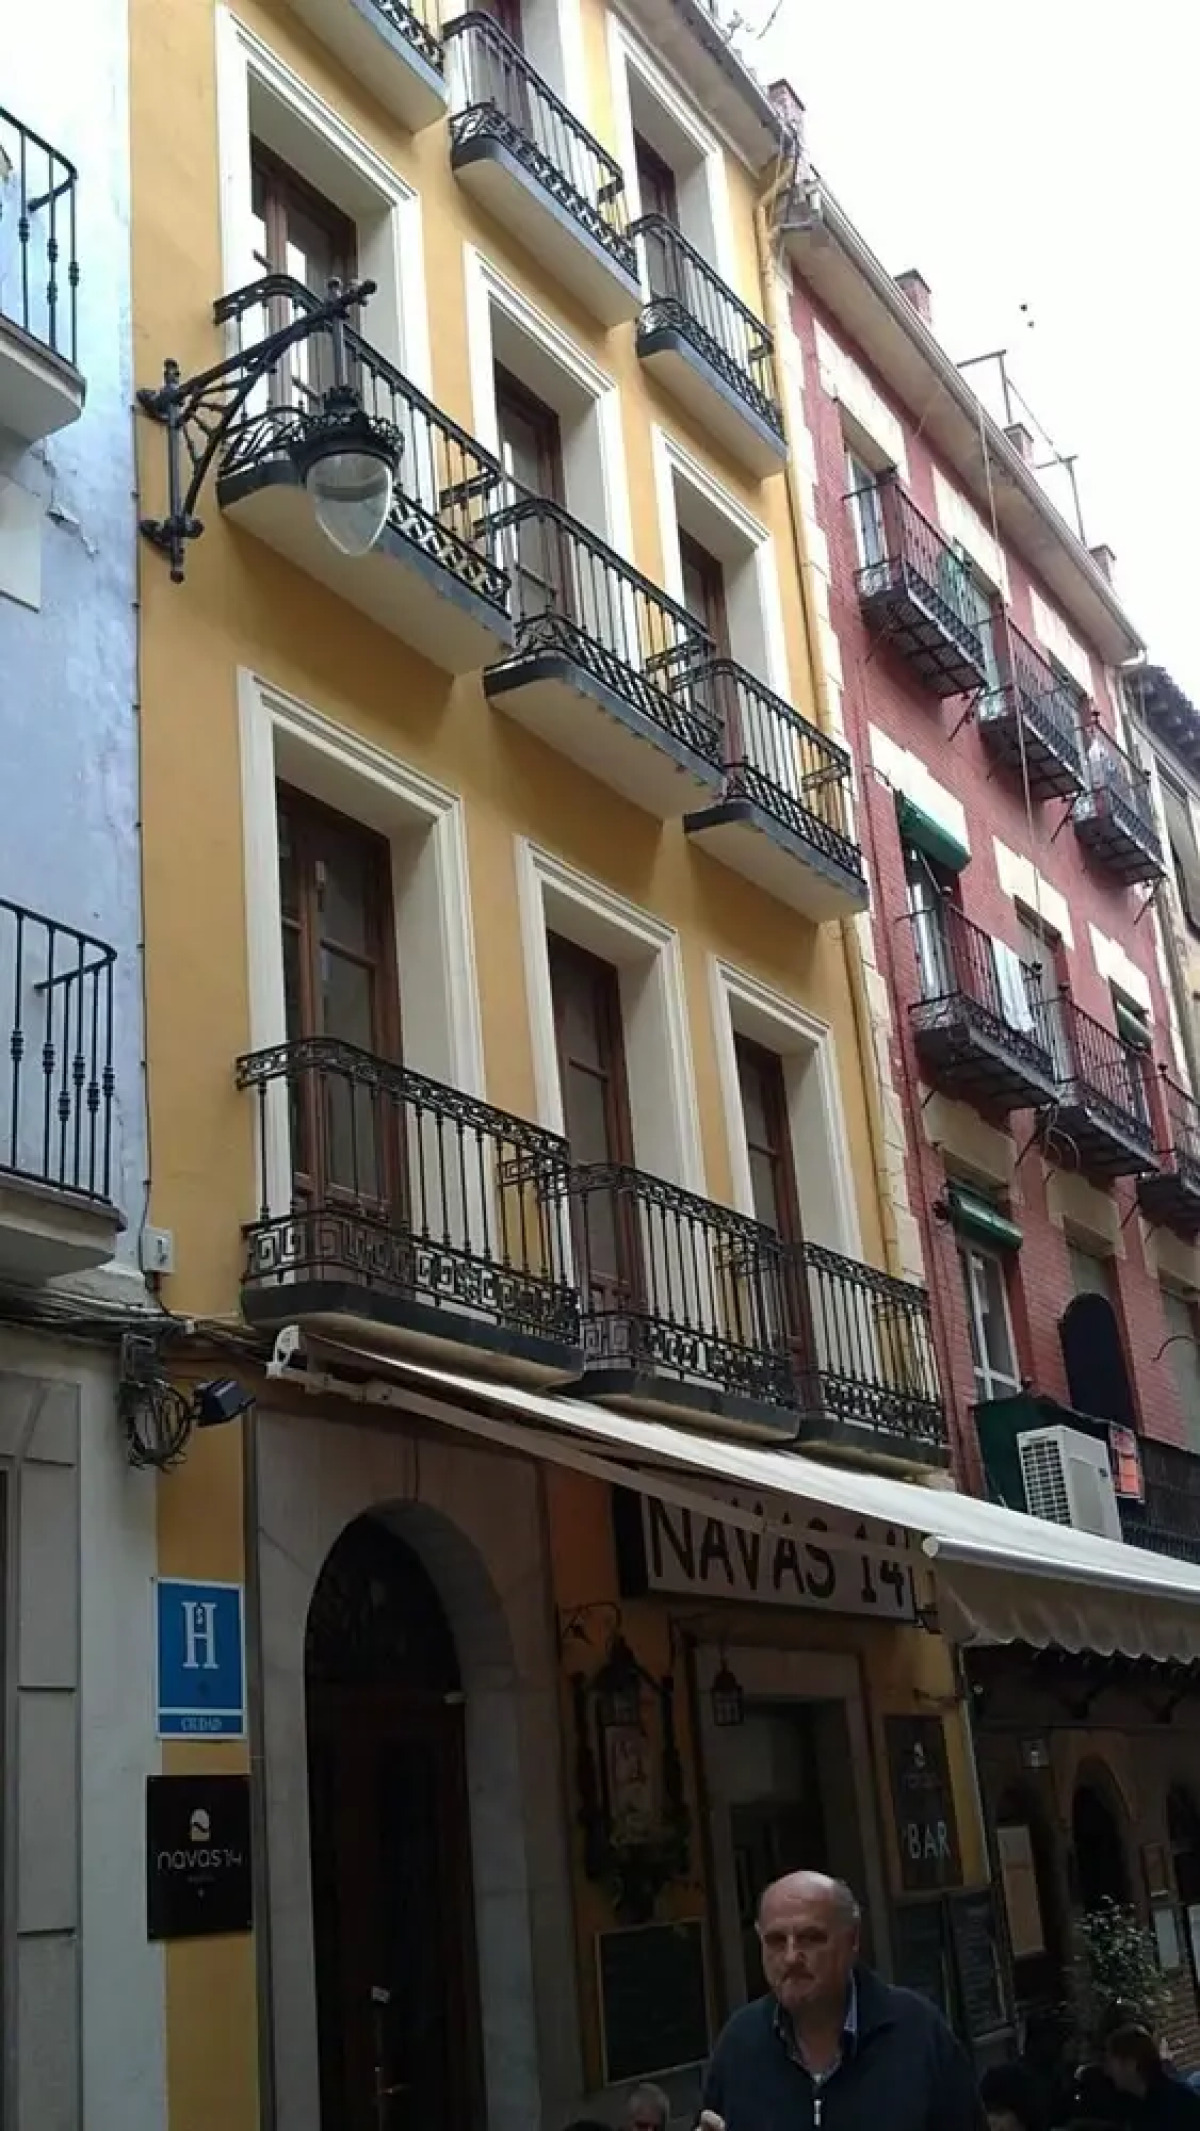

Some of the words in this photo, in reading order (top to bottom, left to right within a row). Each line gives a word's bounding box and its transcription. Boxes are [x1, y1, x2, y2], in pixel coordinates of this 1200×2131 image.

[648, 1495, 836, 1599] NAVAS
[854, 1522, 904, 1607] 14
[907, 1819, 951, 1859] BAR
